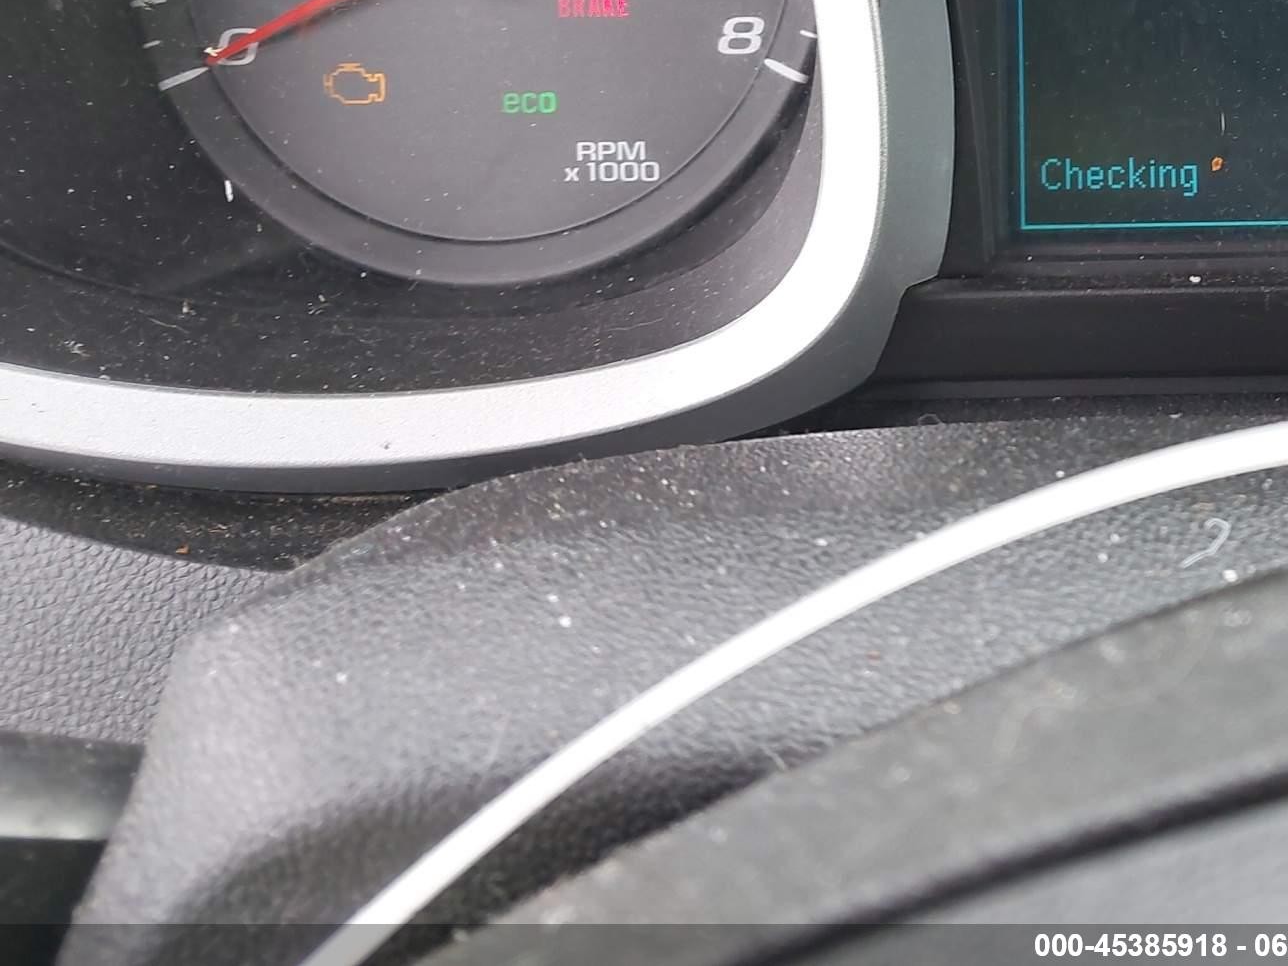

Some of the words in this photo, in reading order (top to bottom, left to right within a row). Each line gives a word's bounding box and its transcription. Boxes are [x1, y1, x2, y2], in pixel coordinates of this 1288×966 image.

[717, 17, 764, 54] 8
[503, 90, 556, 114] eco
[576, 141, 645, 161] RPM
[1040, 157, 1199, 197] Checking
